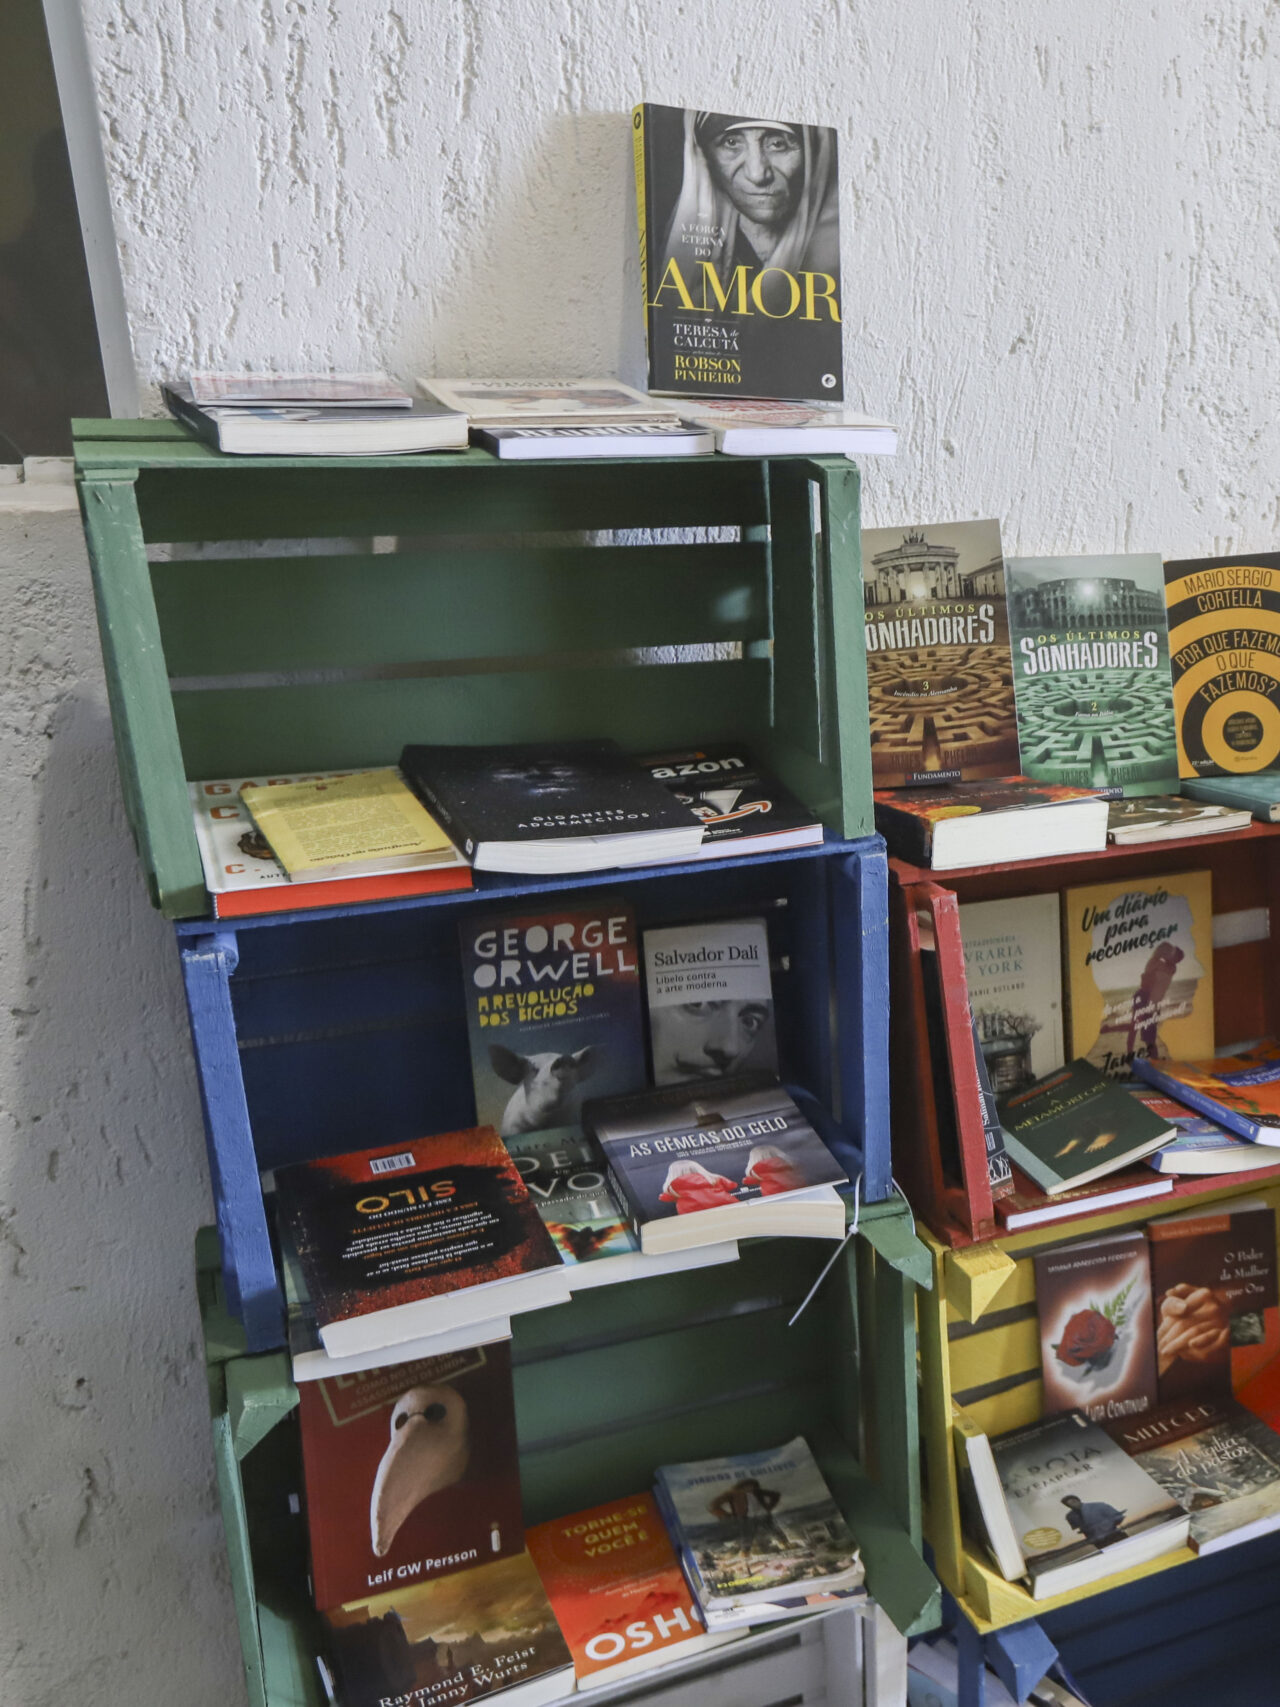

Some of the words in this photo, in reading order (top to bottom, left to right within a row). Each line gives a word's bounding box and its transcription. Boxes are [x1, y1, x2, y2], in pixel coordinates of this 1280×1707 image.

[681, 234, 723, 248] ETERNA
[689, 225, 726, 238] FORÇA
[695, 247, 711, 257] DO
[648, 257, 842, 323] AMOR
[673, 323, 728, 338] TERESA
[674, 336, 739, 351] CALCUTÁ
[675, 355, 741, 372] ROBSON
[674, 370, 741, 385] PINHEIRO
[1183, 575, 1225, 595] MARIO
[1227, 570, 1273, 587] SERGIO
[865, 612, 885, 622] OS
[895, 603, 976, 619] ÚLTIMOS
[1196, 590, 1262, 613] CORTELLA
[865, 603, 995, 652] ONHADORES
[1038, 634, 1057, 644] OS
[1066, 630, 1140, 642] ÚLTIMOS
[1020, 631, 1158, 676] SONHADORES
[1174, 643, 1205, 670] POR
[1205, 632, 1231, 655] QUE
[1215, 655, 1226, 672] O
[1229, 652, 1256, 669] QUE
[922, 681, 929, 691] 3
[929, 686, 958, 697] Alemanha
[1200, 672, 1278, 703] FAZEMOS?
[1091, 702, 1097, 711] 2
[651, 756, 745, 779] azon
[913, 771, 960, 781] FUNDAMENTO
[1061, 769, 1089, 785] JAMES
[518, 812, 650, 829] ADORMECIDOS
[534, 809, 624, 821] GIGANTES
[1081, 907, 1111, 932] Um
[1115, 887, 1167, 918] diário
[474, 917, 627, 958] GEORGE
[1104, 914, 1148, 944] para
[963, 945, 1023, 962] VRARIA
[1086, 923, 1178, 966] recomeçar
[654, 949, 724, 968] Salvador
[728, 945, 759, 961] Dalí
[474, 950, 637, 988] ORWELL
[656, 974, 685, 985] Libelo
[687, 972, 716, 982] contra
[979, 961, 1023, 976] YORK
[478, 996, 490, 1012] A
[493, 983, 595, 1011] REVOLUÇÃO
[664, 984, 683, 993] arte
[685, 980, 728, 989] moderna
[479, 1014, 510, 1028] DOS
[519, 999, 578, 1022] BICHOS
[630, 1143, 651, 1158] AS
[654, 1131, 721, 1153] GÊMEAS
[722, 1126, 746, 1140] DO
[748, 1117, 788, 1135] GELO
[356, 1180, 456, 1214] SILO
[1224, 1253, 1235, 1264] O
[1237, 1249, 1264, 1260] Poder
[1220, 1270, 1231, 1281] da
[1234, 1266, 1269, 1277] Mulher
[1226, 1288, 1243, 1299] que
[1246, 1283, 1265, 1294] Ora
[1107, 1396, 1148, 1419] CONTINUA
[1169, 1448, 1190, 1472] A
[1192, 1435, 1238, 1460] vigília
[1177, 1462, 1198, 1478] do
[1200, 1445, 1249, 1474] pastor
[563, 1504, 648, 1538] TORNE-SE
[584, 1521, 638, 1545] QUEM
[584, 1534, 635, 1558] VOCÊ
[638, 1530, 648, 1541] É
[367, 1569, 394, 1586] Leif
[396, 1562, 422, 1577] GW
[426, 1548, 477, 1569] Persson
[584, 1606, 706, 1661] OSH
[379, 1672, 464, 1707] Raymond
[470, 1664, 490, 1677] E.
[494, 1647, 536, 1668] Feist
[418, 1684, 469, 1707] Janny
[473, 1662, 528, 1687] Wurts
